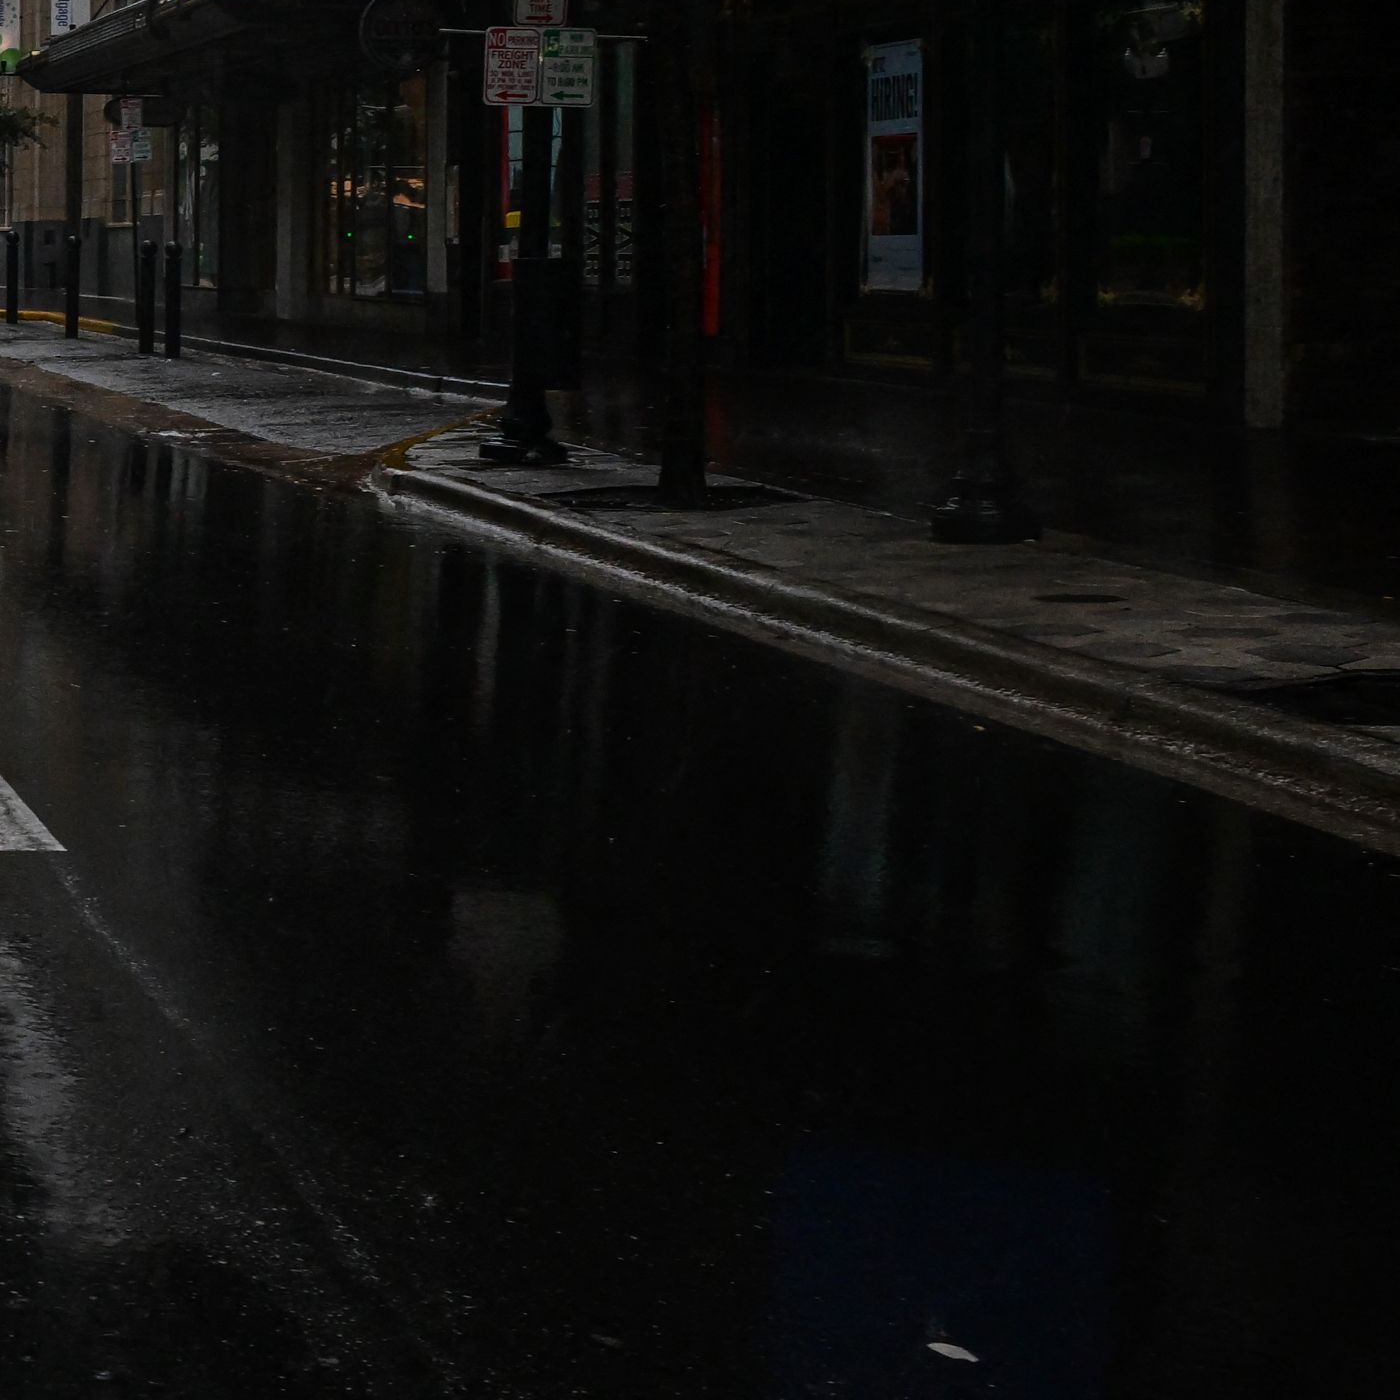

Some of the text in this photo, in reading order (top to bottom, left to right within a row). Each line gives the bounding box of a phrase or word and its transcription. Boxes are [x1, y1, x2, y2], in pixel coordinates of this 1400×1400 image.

[530, 3, 552, 14] TIME
[488, 32, 506, 47] NO
[491, 50, 535, 61] FREIGHT
[498, 60, 527, 70] ZONE
[870, 72, 919, 123] HIRING!
